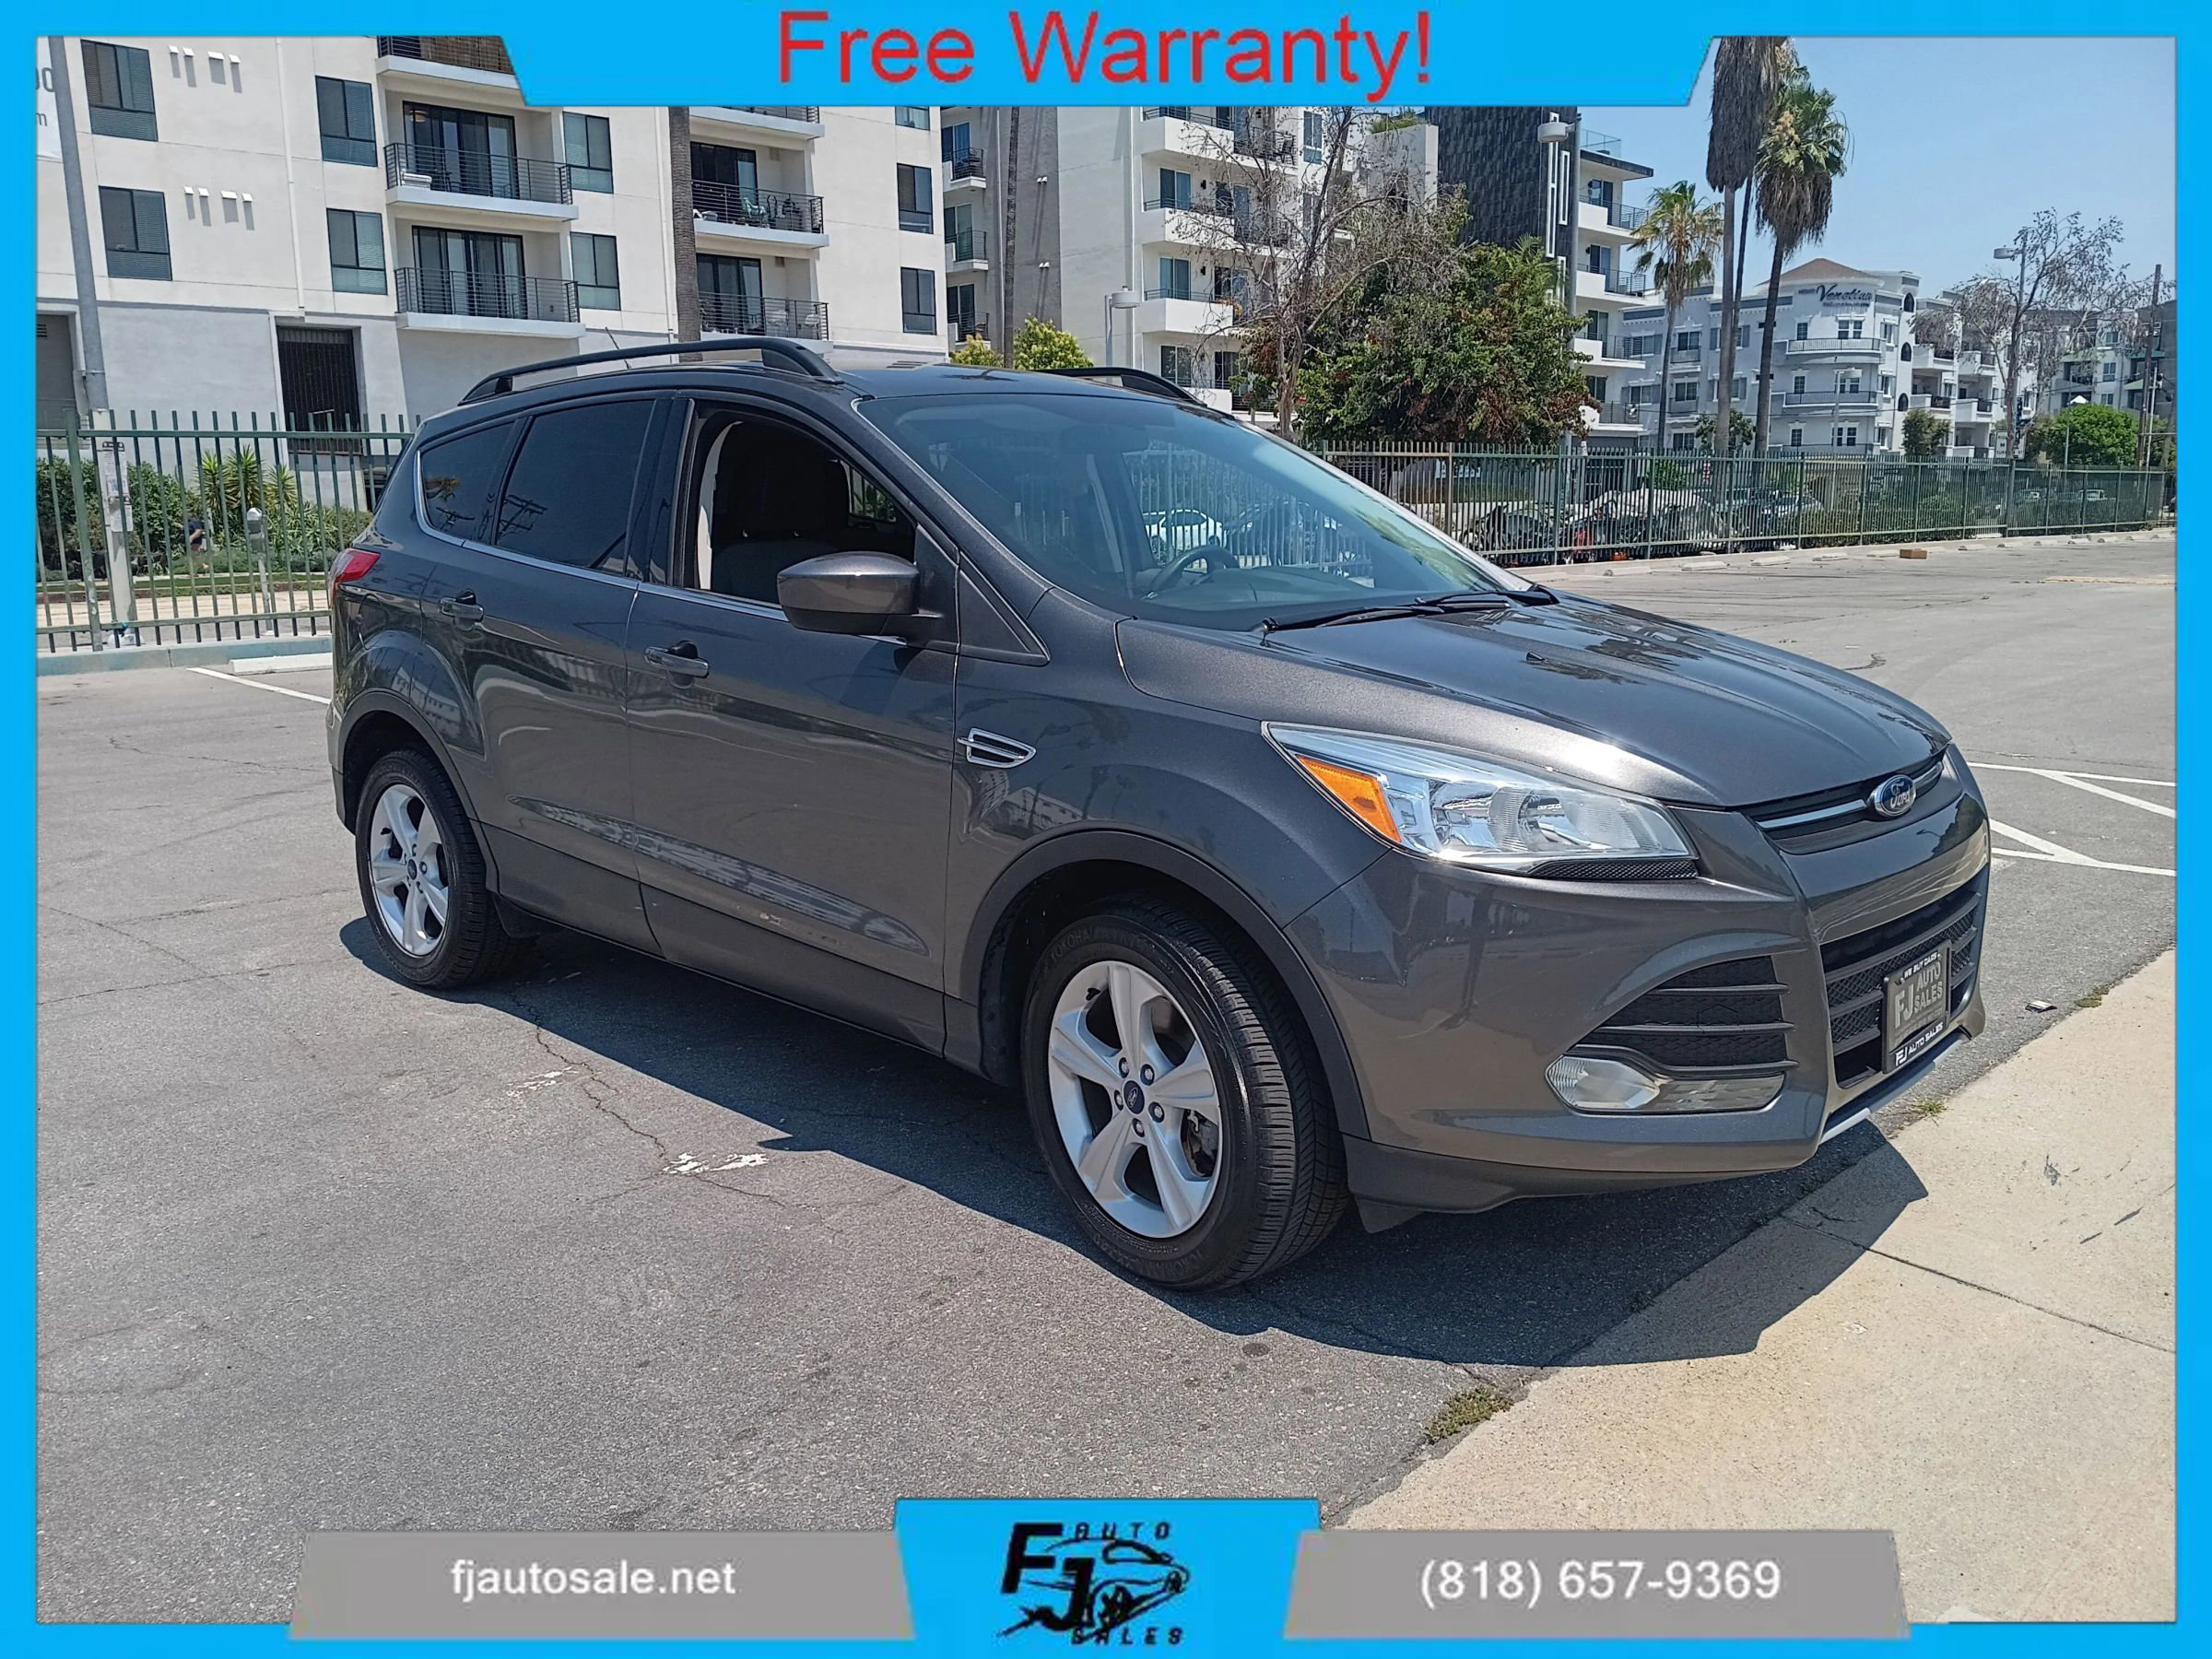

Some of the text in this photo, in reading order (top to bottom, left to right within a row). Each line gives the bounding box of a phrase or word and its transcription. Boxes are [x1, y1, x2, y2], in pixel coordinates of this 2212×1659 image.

[1889, 781, 1911, 809] Ford
[1903, 951, 1937, 980] WE BUY CARS
[1916, 961, 1942, 992] AUTO
[1894, 983, 1914, 1030] FJ
[1913, 981, 1944, 1015] SALES
[1895, 1046, 1908, 1066] FJ
[1908, 1037, 1925, 1055] AUTO
[1924, 1021, 1944, 1042] SALES
